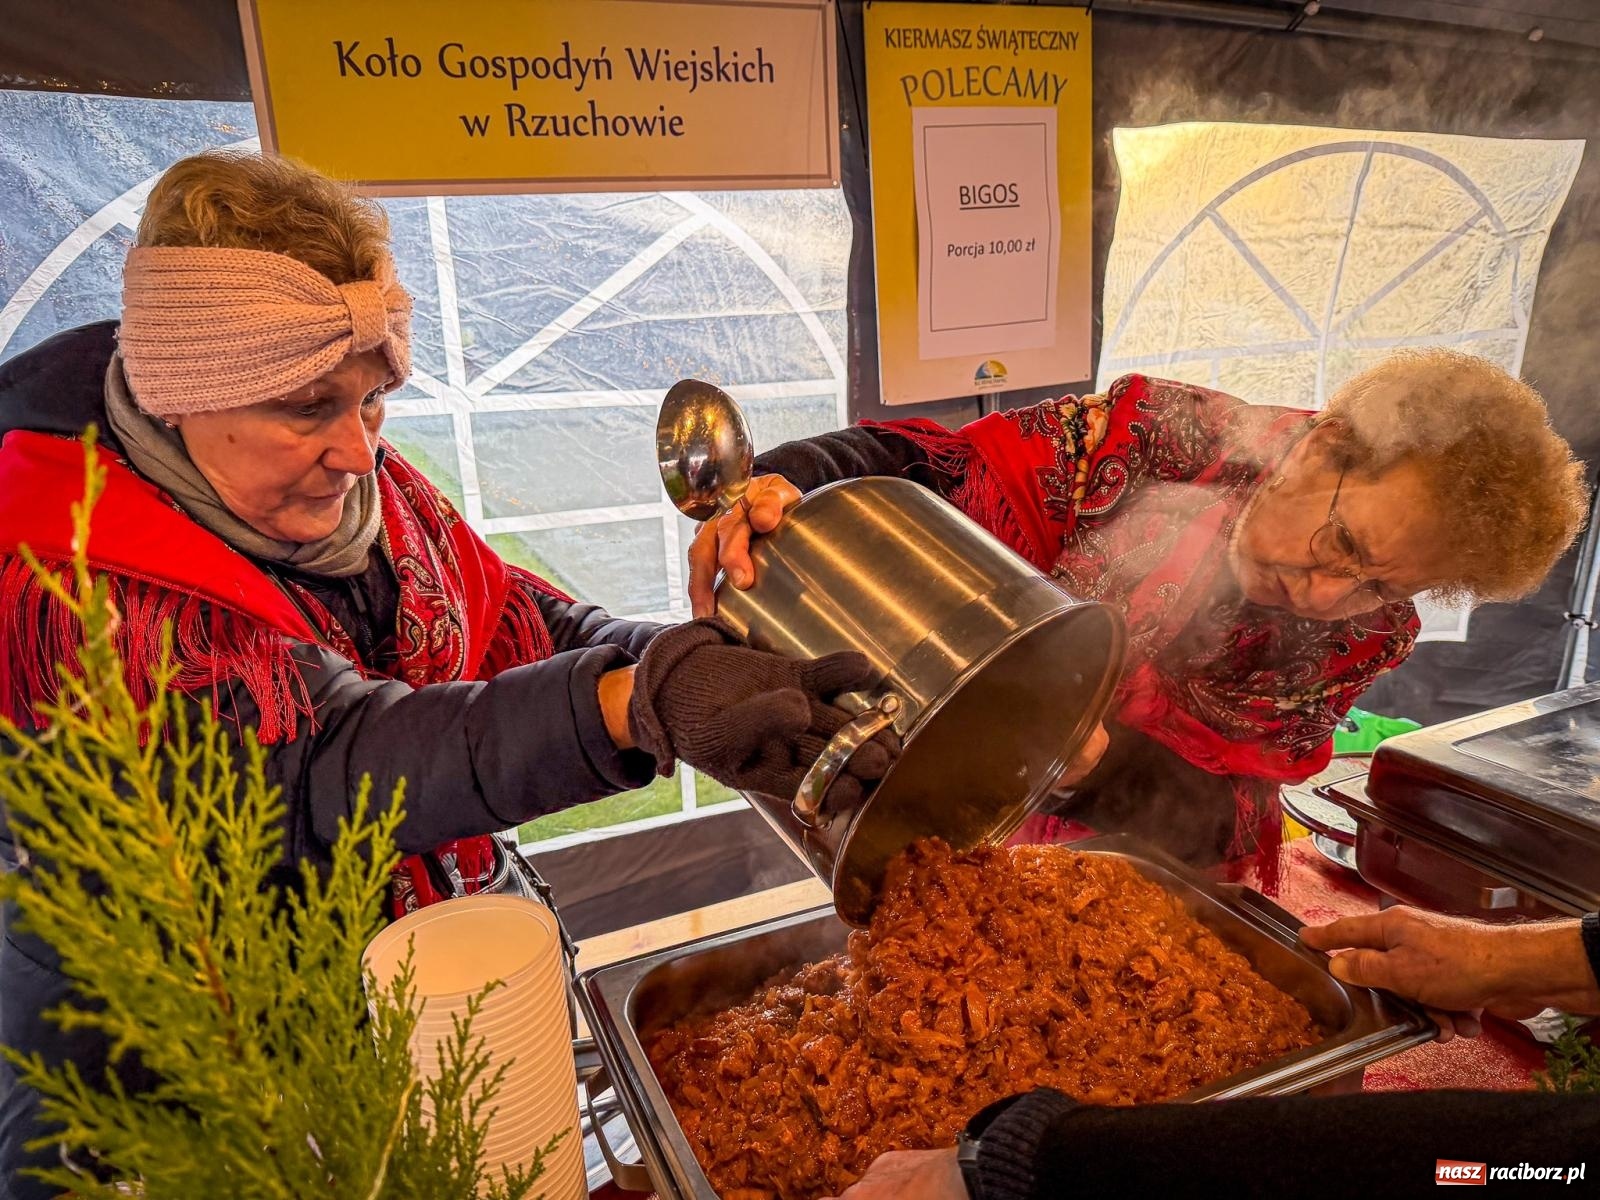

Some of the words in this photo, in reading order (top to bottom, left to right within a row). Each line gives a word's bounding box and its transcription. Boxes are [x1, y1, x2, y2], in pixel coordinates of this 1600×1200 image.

[884, 28, 972, 50] KIERMASZ
[977, 24, 1079, 56] ŚWIĄTECZNY
[333, 38, 422, 78] Koło
[438, 41, 613, 92] Gospodyń
[625, 47, 776, 93] Wiejskich
[900, 65, 1068, 106] POLECAMY
[459, 113, 491, 137] w
[504, 100, 686, 138] Rzuchowie
[959, 183, 1020, 206] BIGOS
[947, 241, 985, 259] Porcja
[988, 240, 1023, 256] 10,00
[1025, 238, 1036, 252] zł
